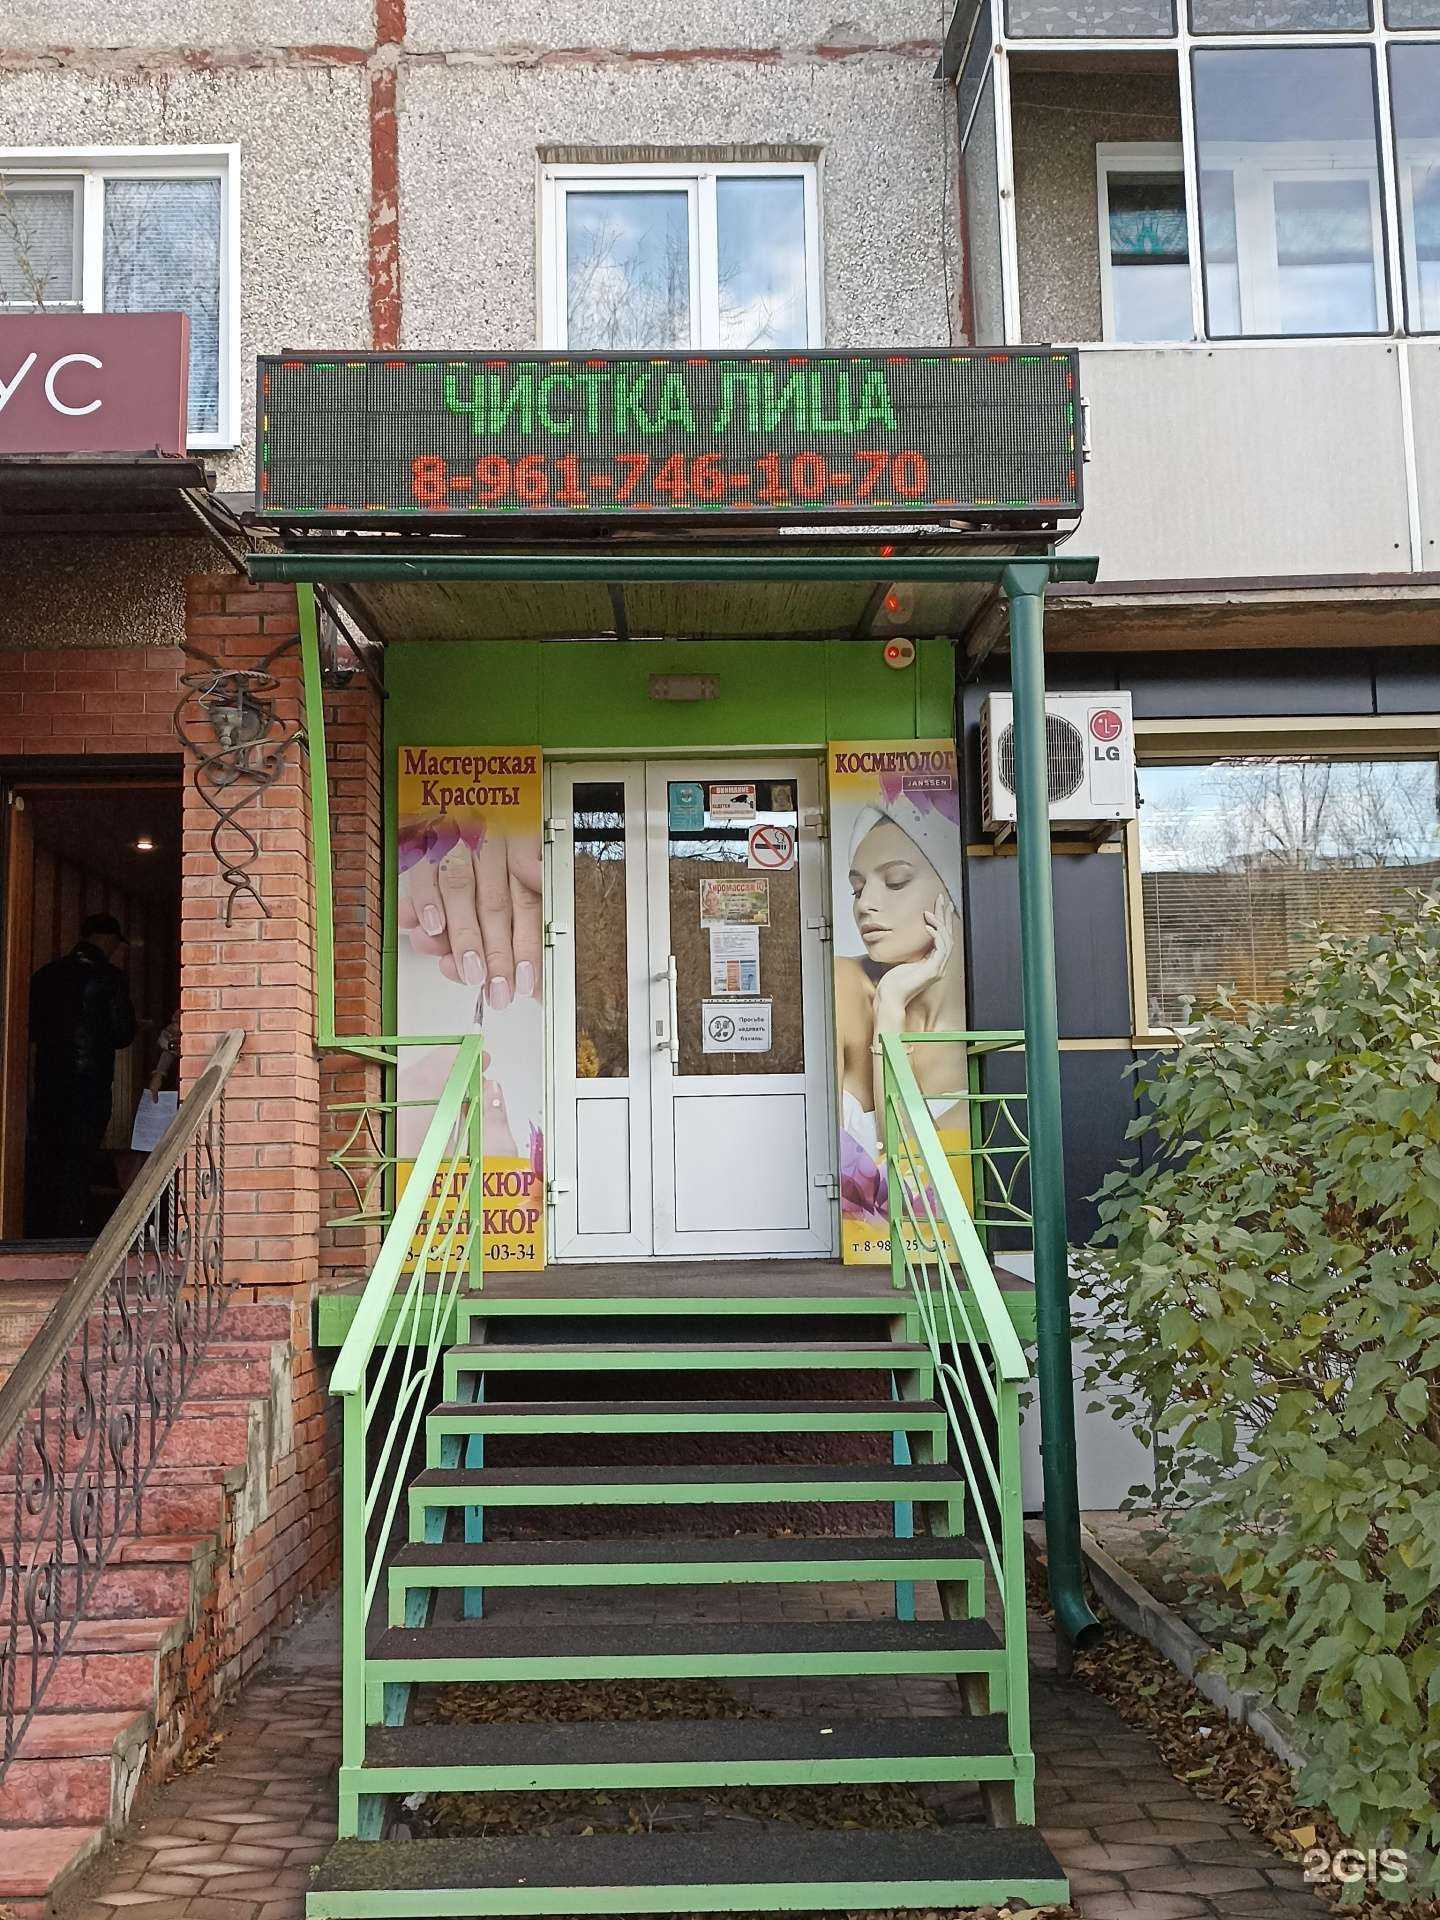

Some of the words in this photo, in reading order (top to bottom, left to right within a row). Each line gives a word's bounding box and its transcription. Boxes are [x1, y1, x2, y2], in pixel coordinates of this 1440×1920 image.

[442, 370, 697, 436] ЧИСТКА
[713, 370, 898, 433] ЛИЦА
[411, 453, 928, 502] 8-961-746-10-70
[404, 749, 537, 783] Мастерская
[835, 750, 954, 773] КОСМЕТОЛОГ
[1094, 746, 1120, 761] LG
[421, 780, 520, 814] Красоты
[907, 779, 947, 787] JANSSEN
